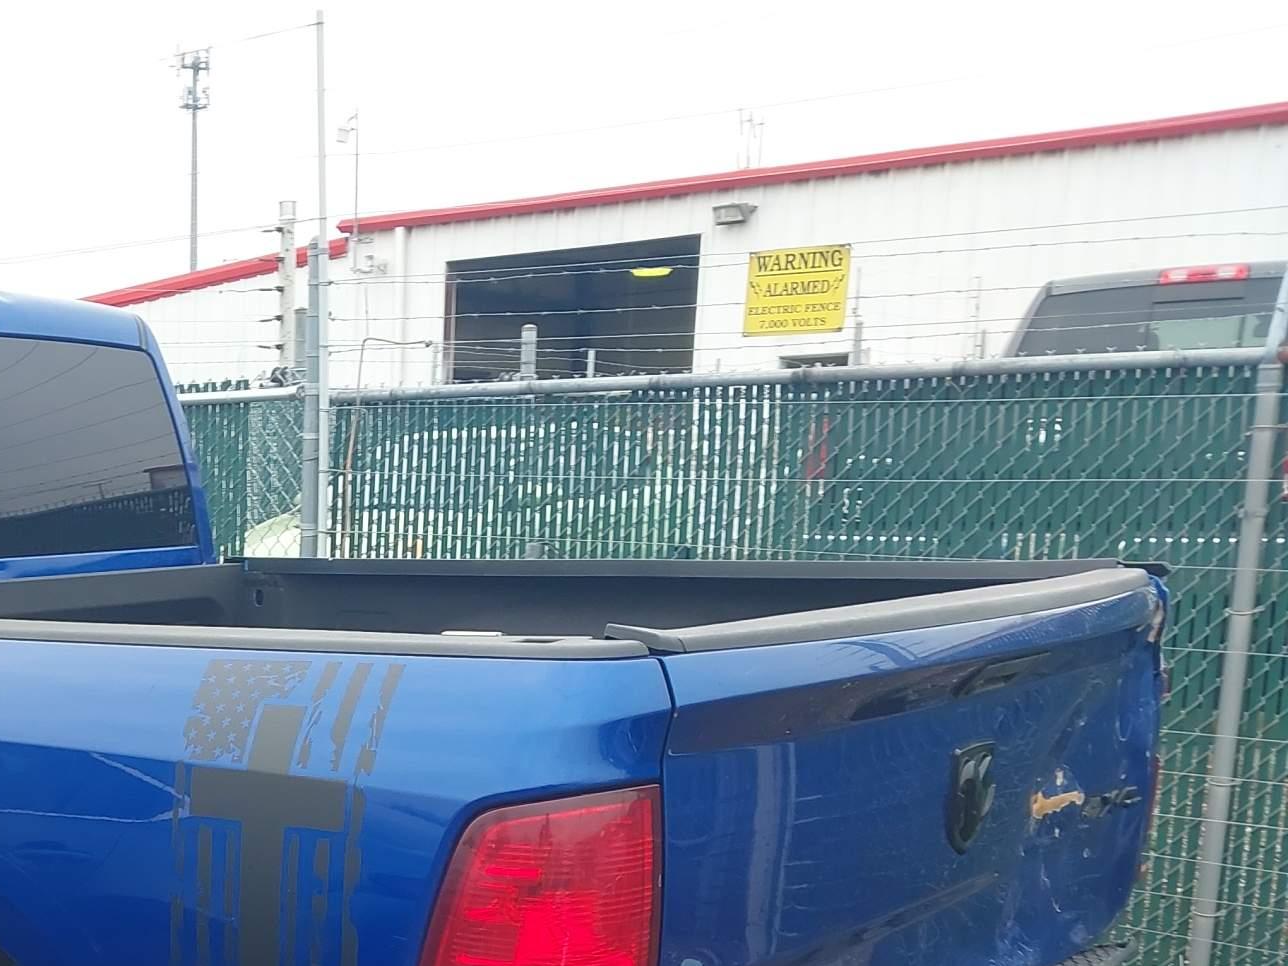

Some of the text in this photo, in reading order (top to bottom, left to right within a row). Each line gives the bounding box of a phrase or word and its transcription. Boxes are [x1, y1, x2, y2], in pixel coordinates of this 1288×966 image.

[756, 249, 843, 273] WARNING
[763, 279, 831, 298] ALARMED
[748, 302, 841, 316] ELECTRIC FENCE
[791, 317, 826, 328] VOLTS
